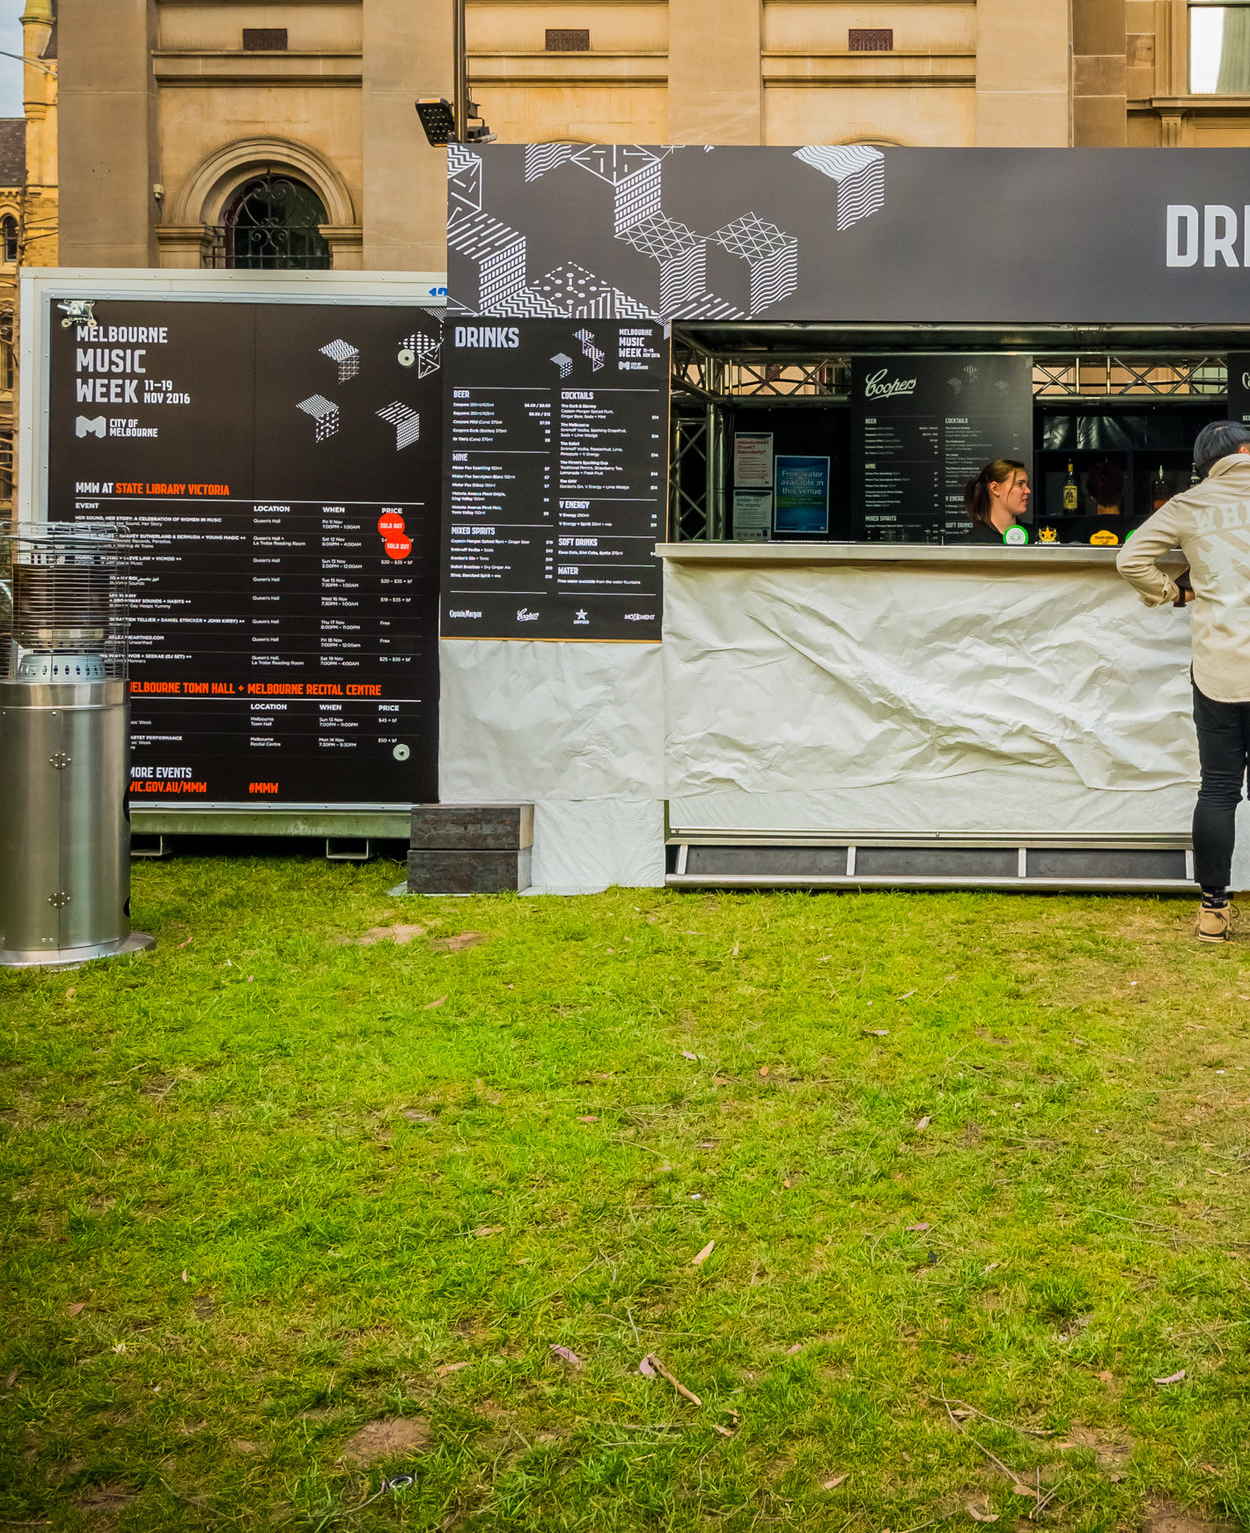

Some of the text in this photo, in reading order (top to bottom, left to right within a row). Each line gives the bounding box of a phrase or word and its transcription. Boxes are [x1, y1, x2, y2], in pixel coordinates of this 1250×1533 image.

[76, 326, 168, 343] MELBOURNE
[455, 327, 519, 347] DRINKS
[619, 337, 644, 346] MUSIC
[619, 348, 641, 357] WEEK
[76, 349, 146, 373] MUSIC
[865, 369, 917, 401] Coopers
[76, 379, 138, 403] WEEK
[144, 393, 190, 404] NOV 2016
[110, 419, 138, 427] CITY OF
[110, 428, 158, 437] MELBOURNE
[76, 482, 230, 495] MMW AT STATE LIBRARY VICTORIA
[559, 501, 590, 509] V ENERGY
[472, 527, 495, 535] SPIRITS
[558, 567, 578, 575] WATER
[183, 682, 209, 693] TOWN
[212, 683, 235, 694] HALL
[247, 684, 304, 694] MELBOURNE
[306, 684, 343, 695] RECITAL
[346, 685, 381, 695] CENTRE
[156, 767, 192, 778] EVENTS
[249, 783, 278, 794] #MMW
